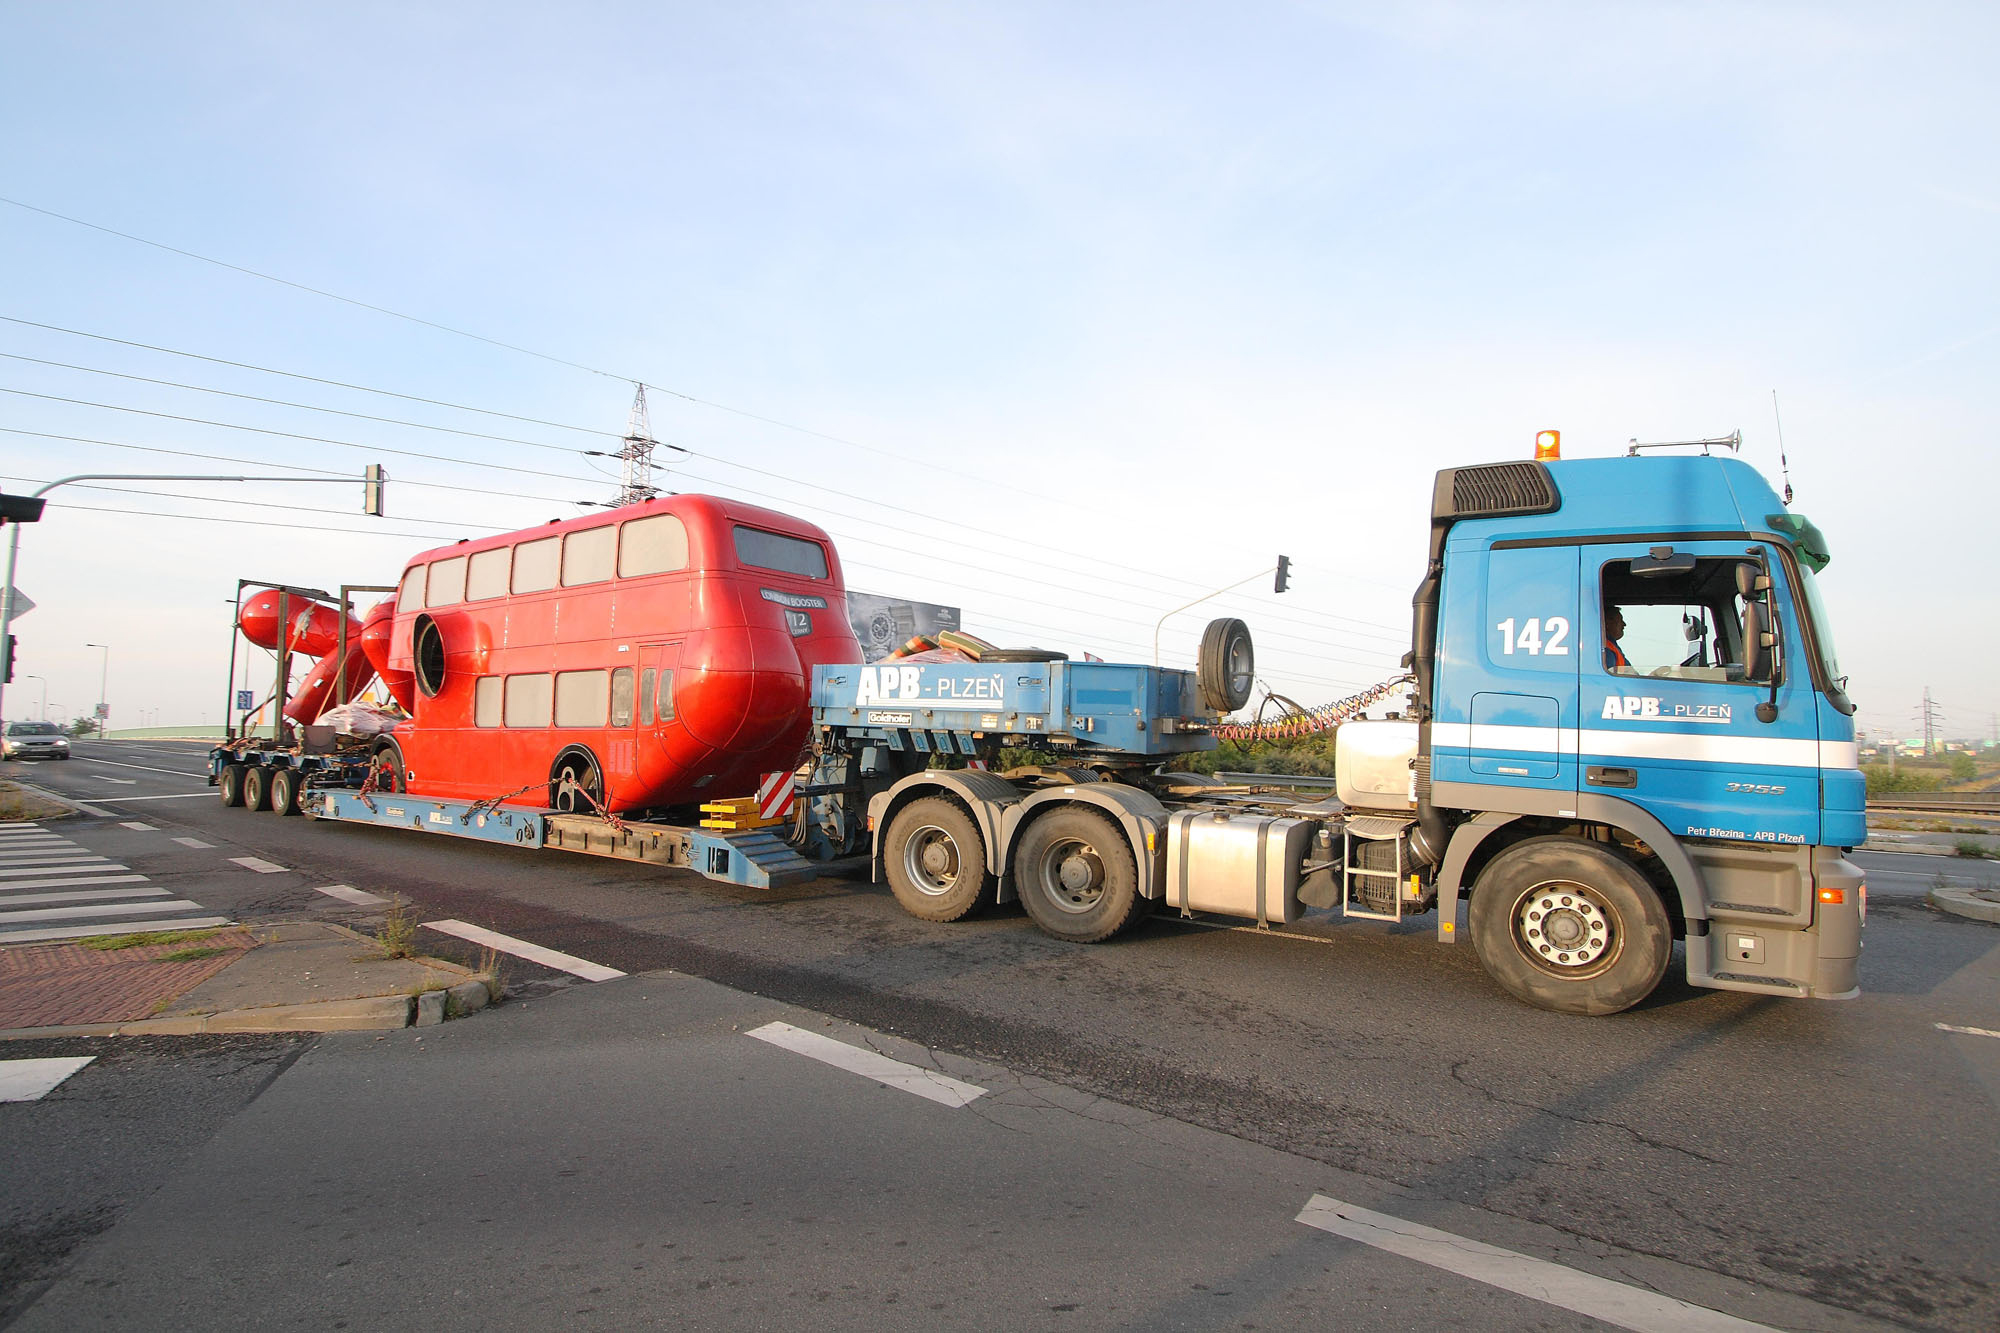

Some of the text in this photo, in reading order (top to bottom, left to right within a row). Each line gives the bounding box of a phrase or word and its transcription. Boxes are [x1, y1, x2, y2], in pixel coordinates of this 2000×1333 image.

[790, 597, 823, 608] BOOSTER
[793, 613, 807, 626] 12
[1497, 616, 1569, 656] 142
[856, 667, 921, 706] APB
[937, 673, 1004, 698] PLZEŇ
[1602, 695, 1660, 719] APB
[1675, 703, 1732, 718] PLZEŇ
[870, 713, 911, 724] Goldhofer
[1724, 782, 1787, 796] 3355
[1687, 826, 1707, 836] Petr
[1709, 828, 1745, 839] Březina
[1753, 832, 1776, 841] APB
[1778, 833, 1805, 843] Plzeň
